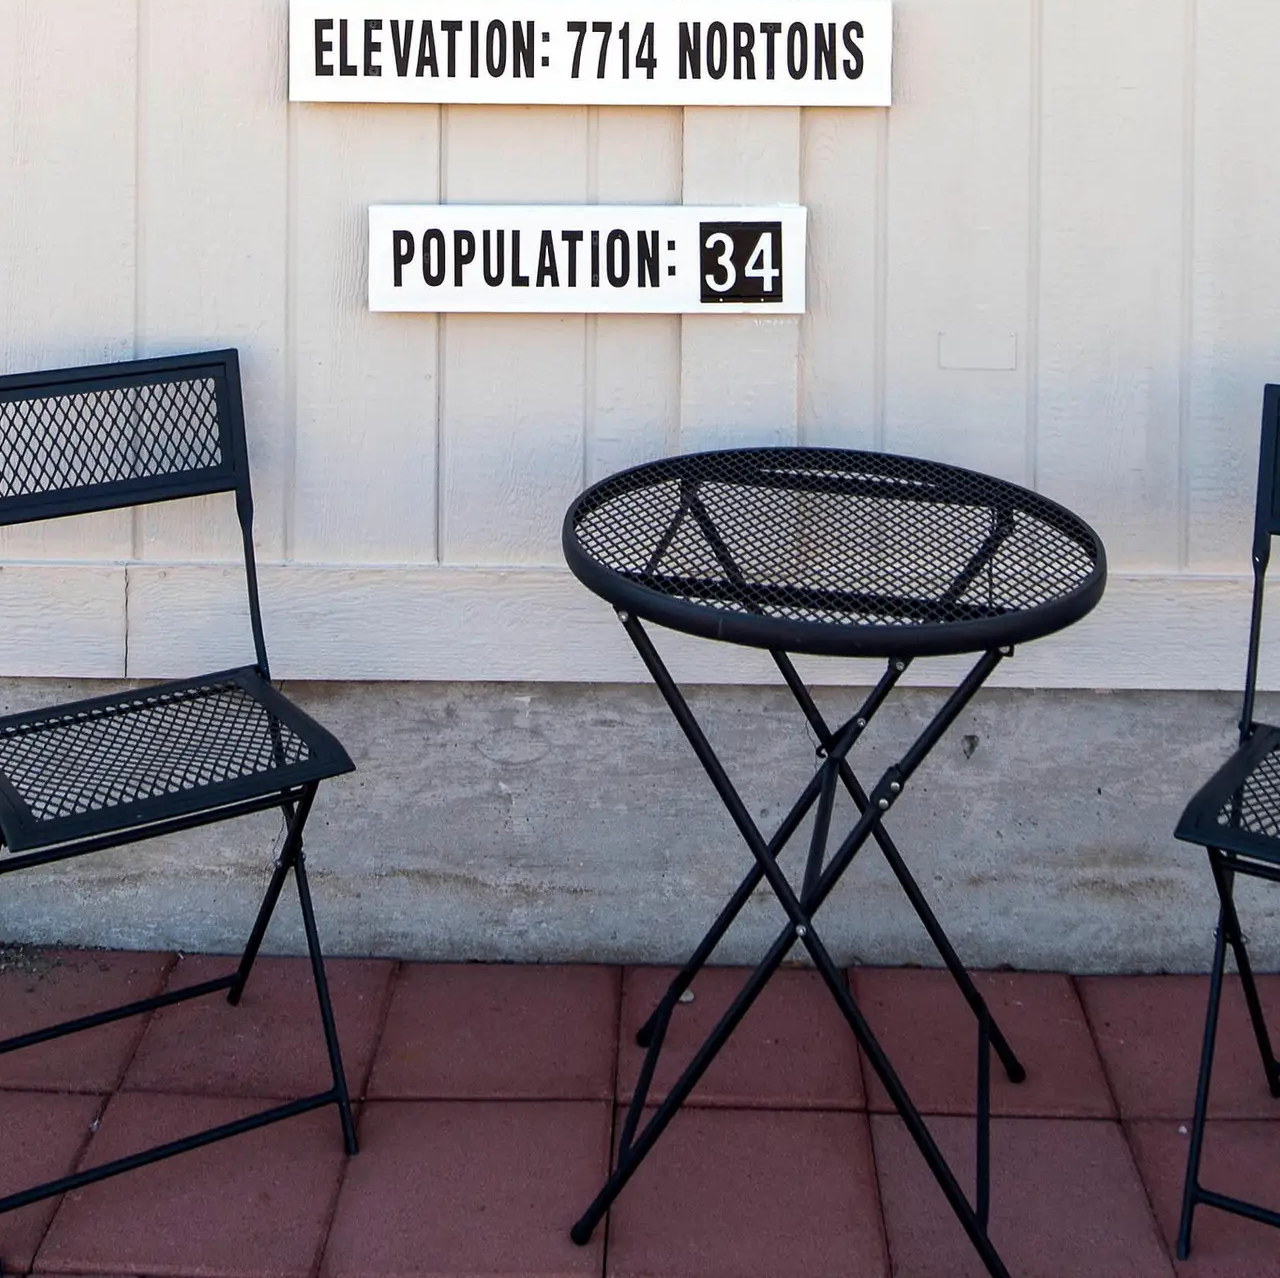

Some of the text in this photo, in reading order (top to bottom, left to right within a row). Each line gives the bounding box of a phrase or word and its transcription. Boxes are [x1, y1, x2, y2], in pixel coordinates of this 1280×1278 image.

[314, 18, 865, 81] ELEVATION: 7714 NORTONS
[392, 227, 780, 293] POPULATION: 34
